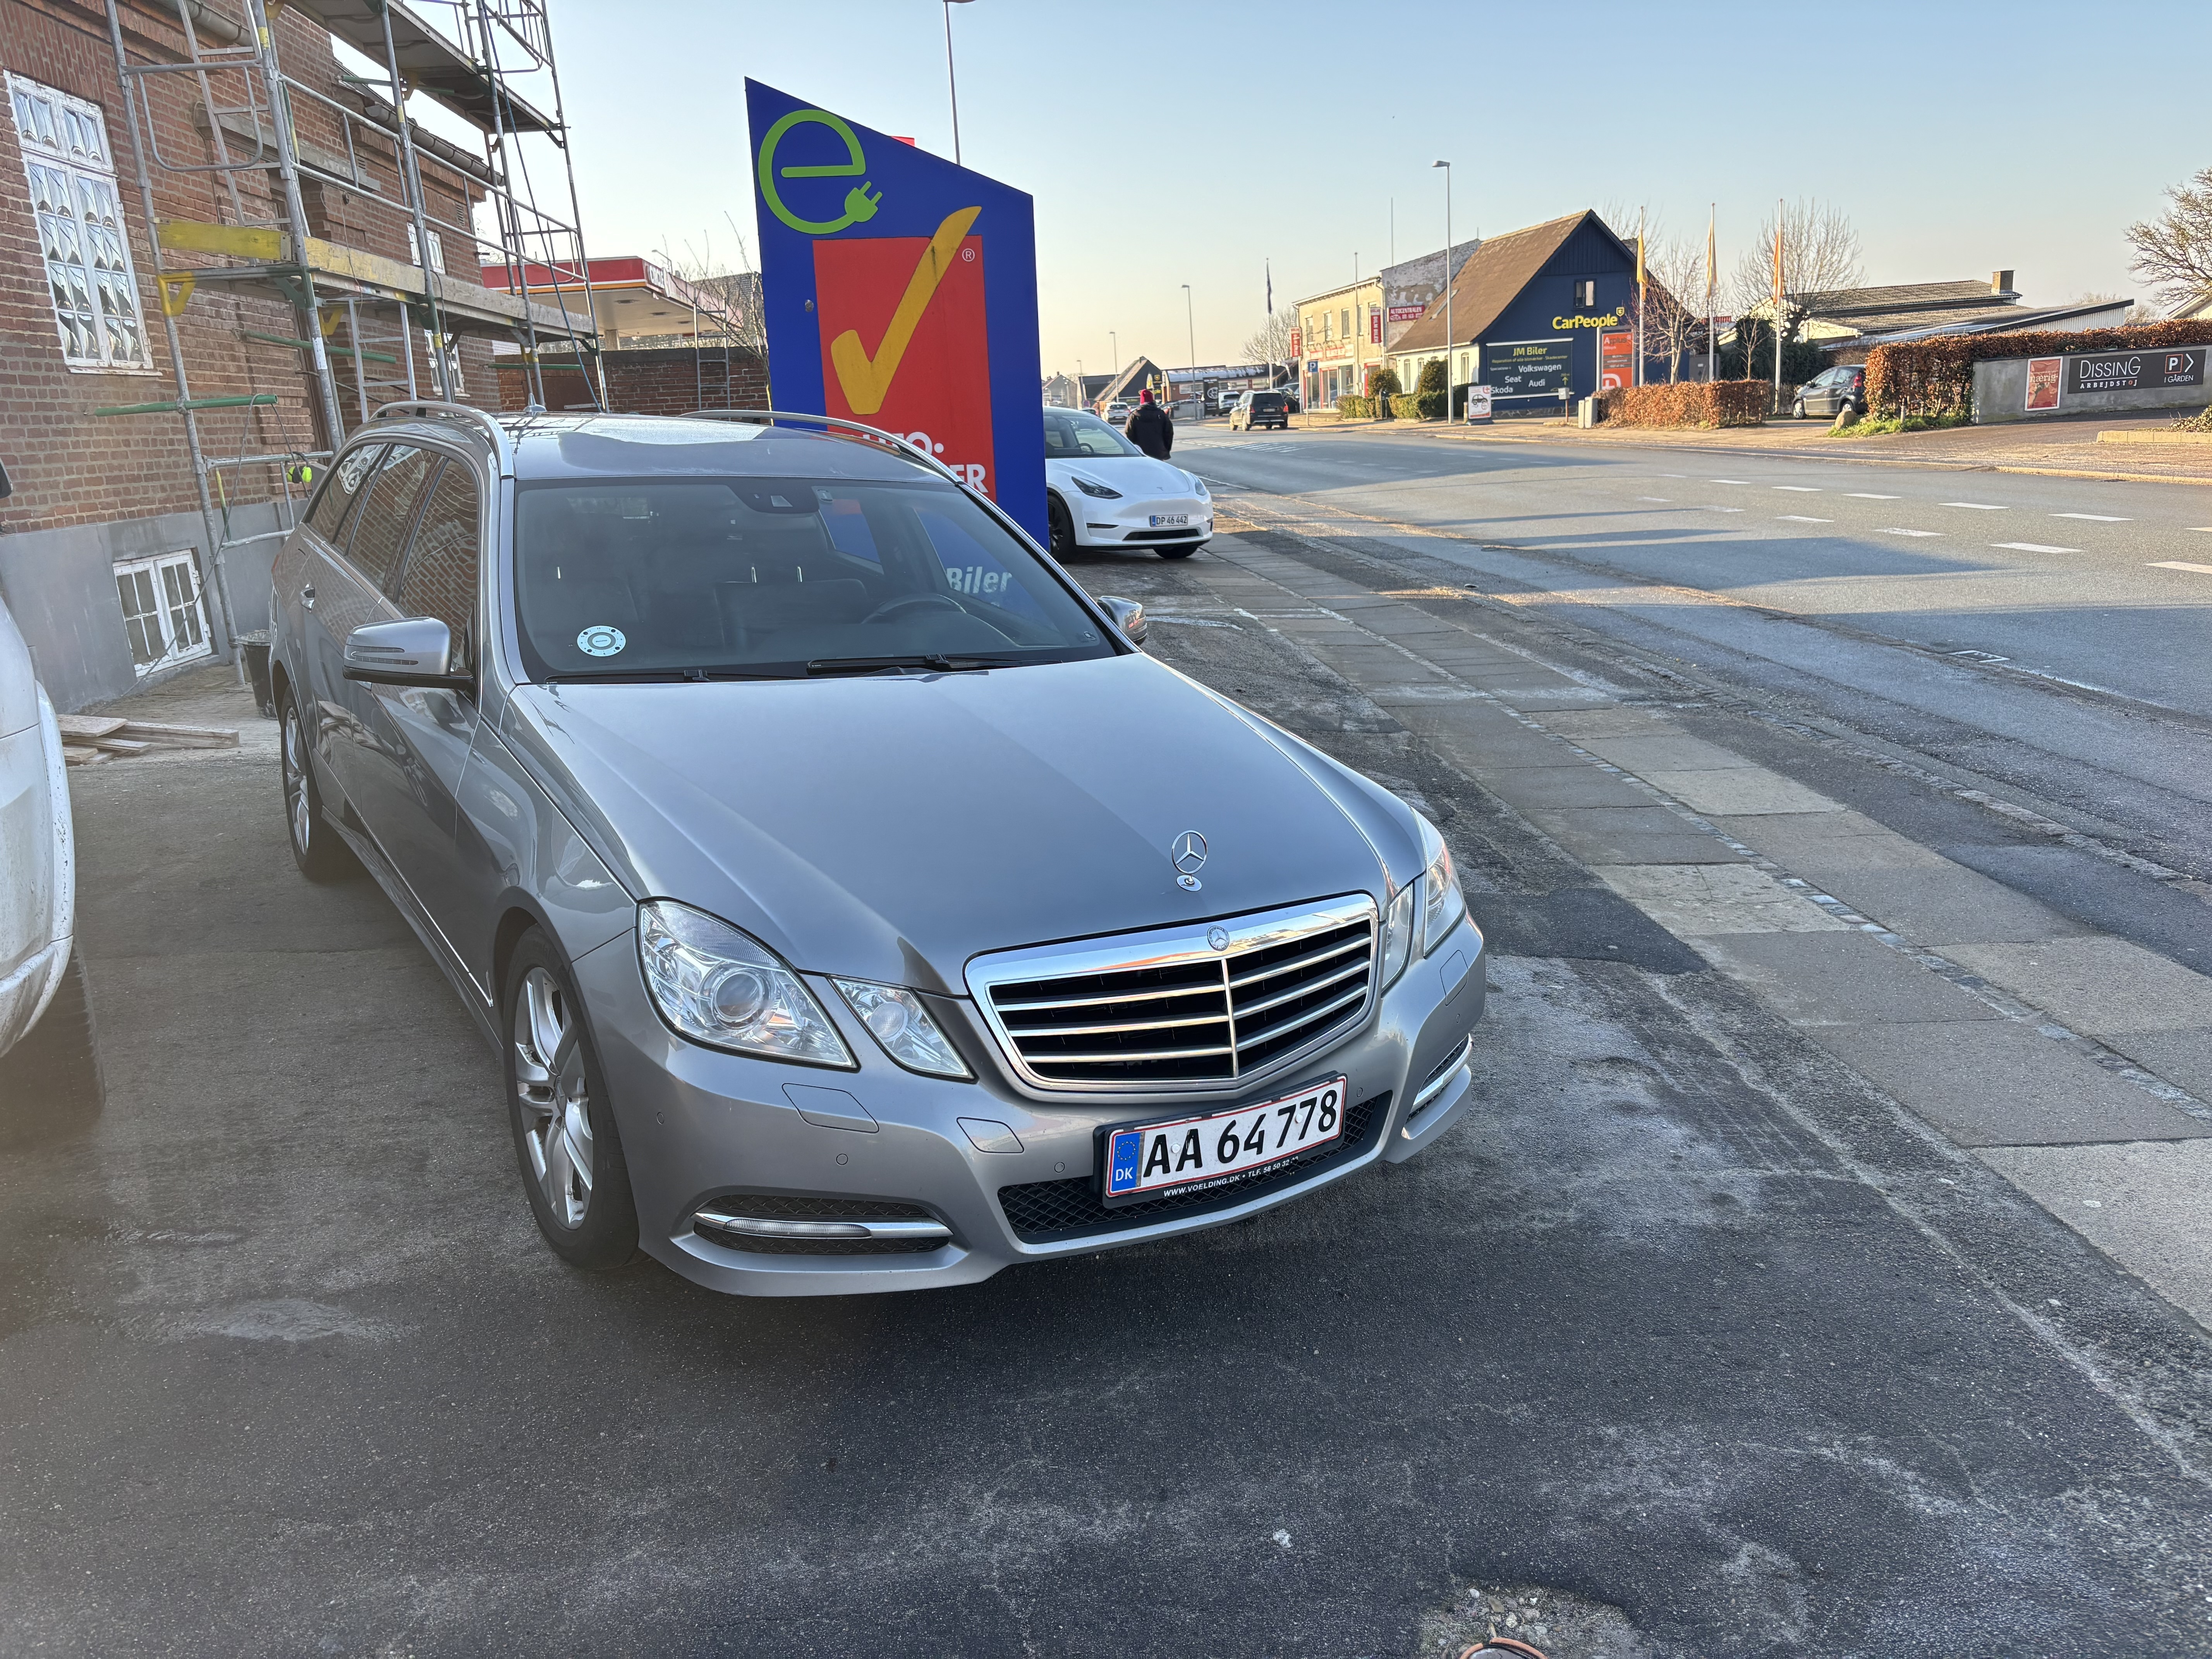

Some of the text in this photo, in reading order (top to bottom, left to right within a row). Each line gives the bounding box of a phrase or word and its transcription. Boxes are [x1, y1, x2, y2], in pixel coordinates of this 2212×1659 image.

[1553, 313, 1618, 330] CarPeople
[1513, 347, 1547, 356] JM Biler
[1310, 362, 1316, 371] P
[1518, 364, 1561, 373] Volkswagen
[2080, 356, 2141, 378] DISSING
[2169, 357, 2178, 370] P
[1528, 379, 1545, 387] Audi
[2168, 374, 2194, 383] GÅRDEN
[1491, 386, 1513, 394] Skoda
[1156, 517, 1165, 525] DP
[946, 567, 1012, 594] Biler
[1143, 1089, 1338, 1178] AA 64 778
[1115, 1166, 1133, 1182] DK
[1164, 1174, 1240, 1197] WWW.VOELDING.DK
[1248, 1169, 1261, 1178] TLF.
